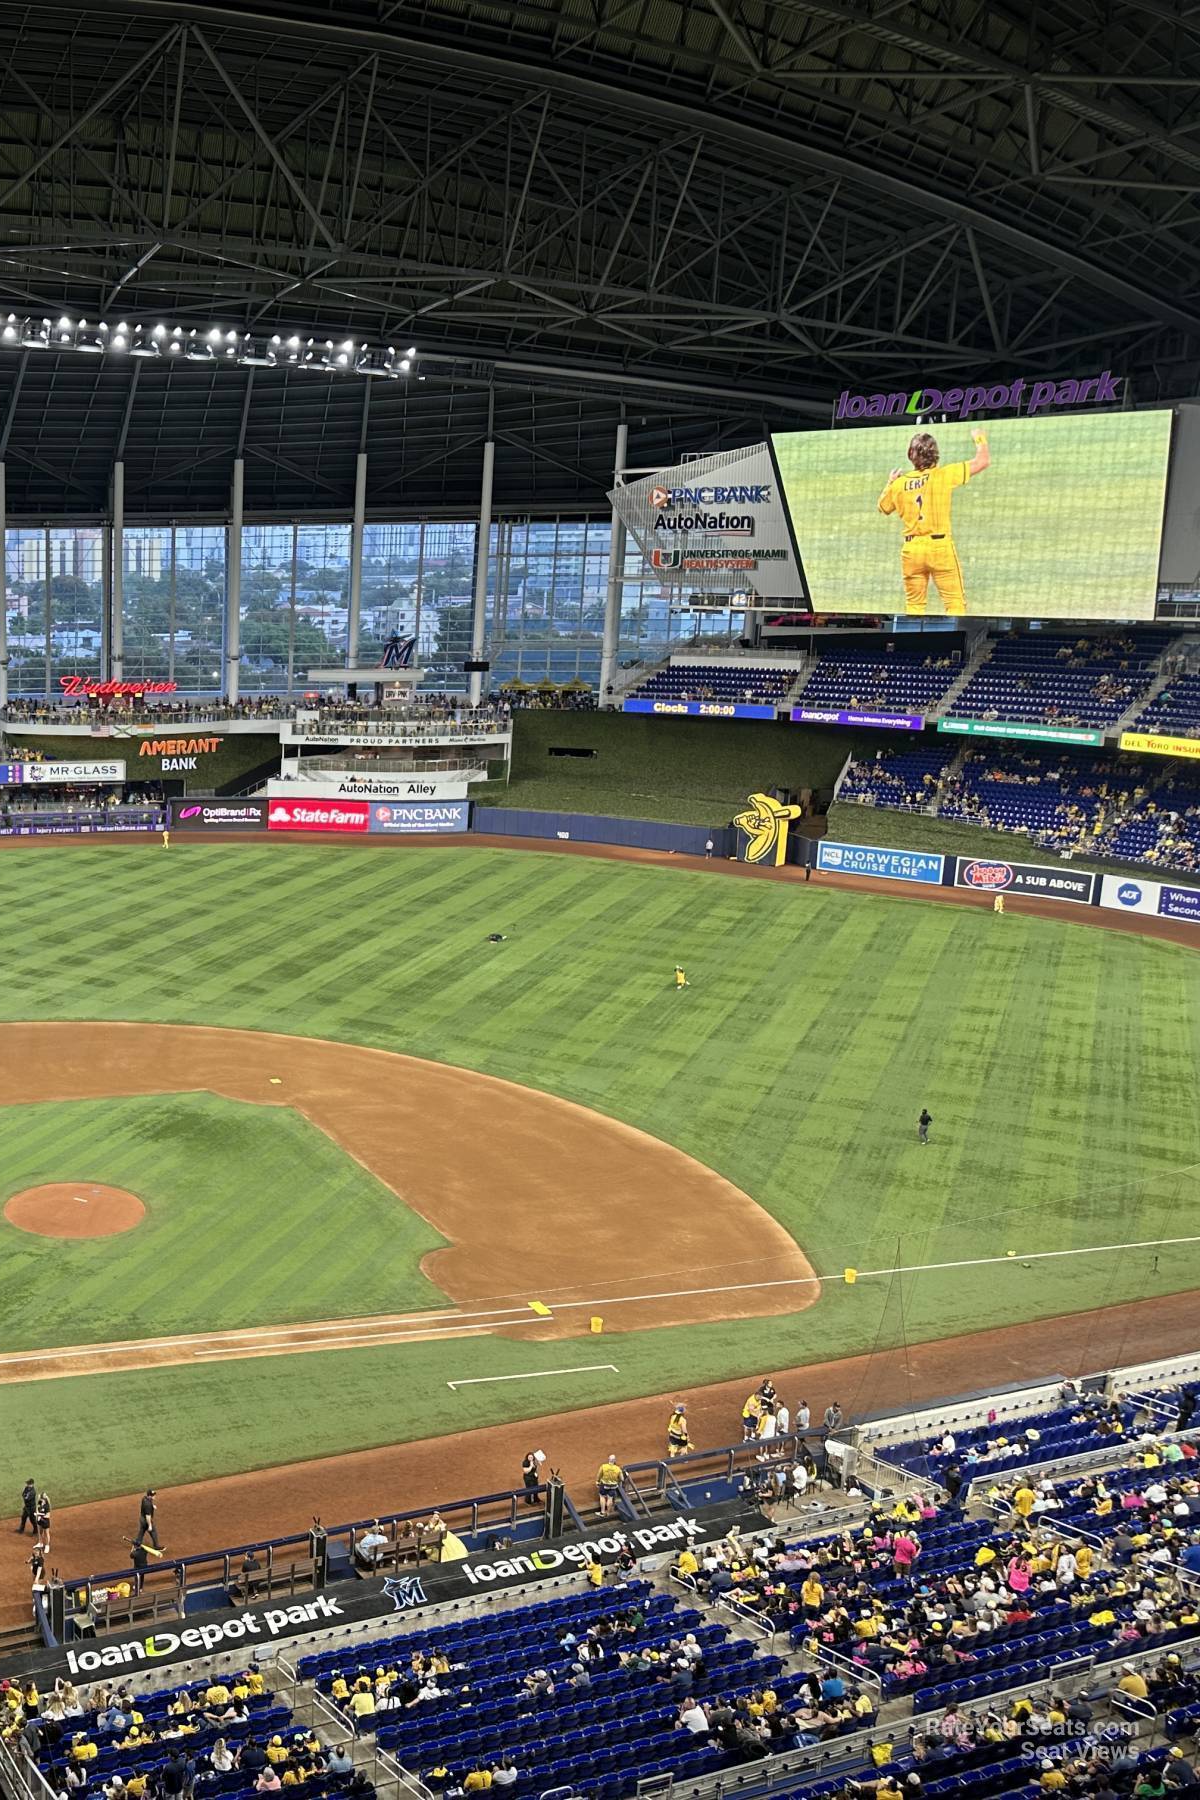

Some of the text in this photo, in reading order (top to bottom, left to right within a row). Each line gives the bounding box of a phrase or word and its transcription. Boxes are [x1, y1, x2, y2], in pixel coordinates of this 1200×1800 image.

[836, 370, 1122, 419] loanDepot park
[671, 485, 771, 504] PNC BANK
[654, 512, 752, 530] AutoNation
[684, 549, 737, 559] UNIVERSITY
[753, 550, 786, 559] MIAMI
[683, 559, 755, 569] HEALTH SYSTEM
[735, 594, 747, 606] 42
[60, 675, 177, 696] Budweiser
[653, 702, 735, 715] Clock: 2:00:00
[139, 738, 220, 756] AMERANT
[161, 757, 197, 771] BANK
[338, 783, 437, 796] AutoNation Alley
[292, 807, 366, 825] State Farm
[392, 807, 462, 821] PNC BANK
[843, 850, 938, 870] NORWEGIAN
[843, 860, 919, 877] CRUISE LINE
[1014, 874, 1086, 892] A SUB ABOVE
[1120, 890, 1140, 900] ADT
[1169, 892, 1199, 905] When
[461, 1516, 706, 1584] loanDepot park
[66, 1594, 345, 1674] loanDepot park
